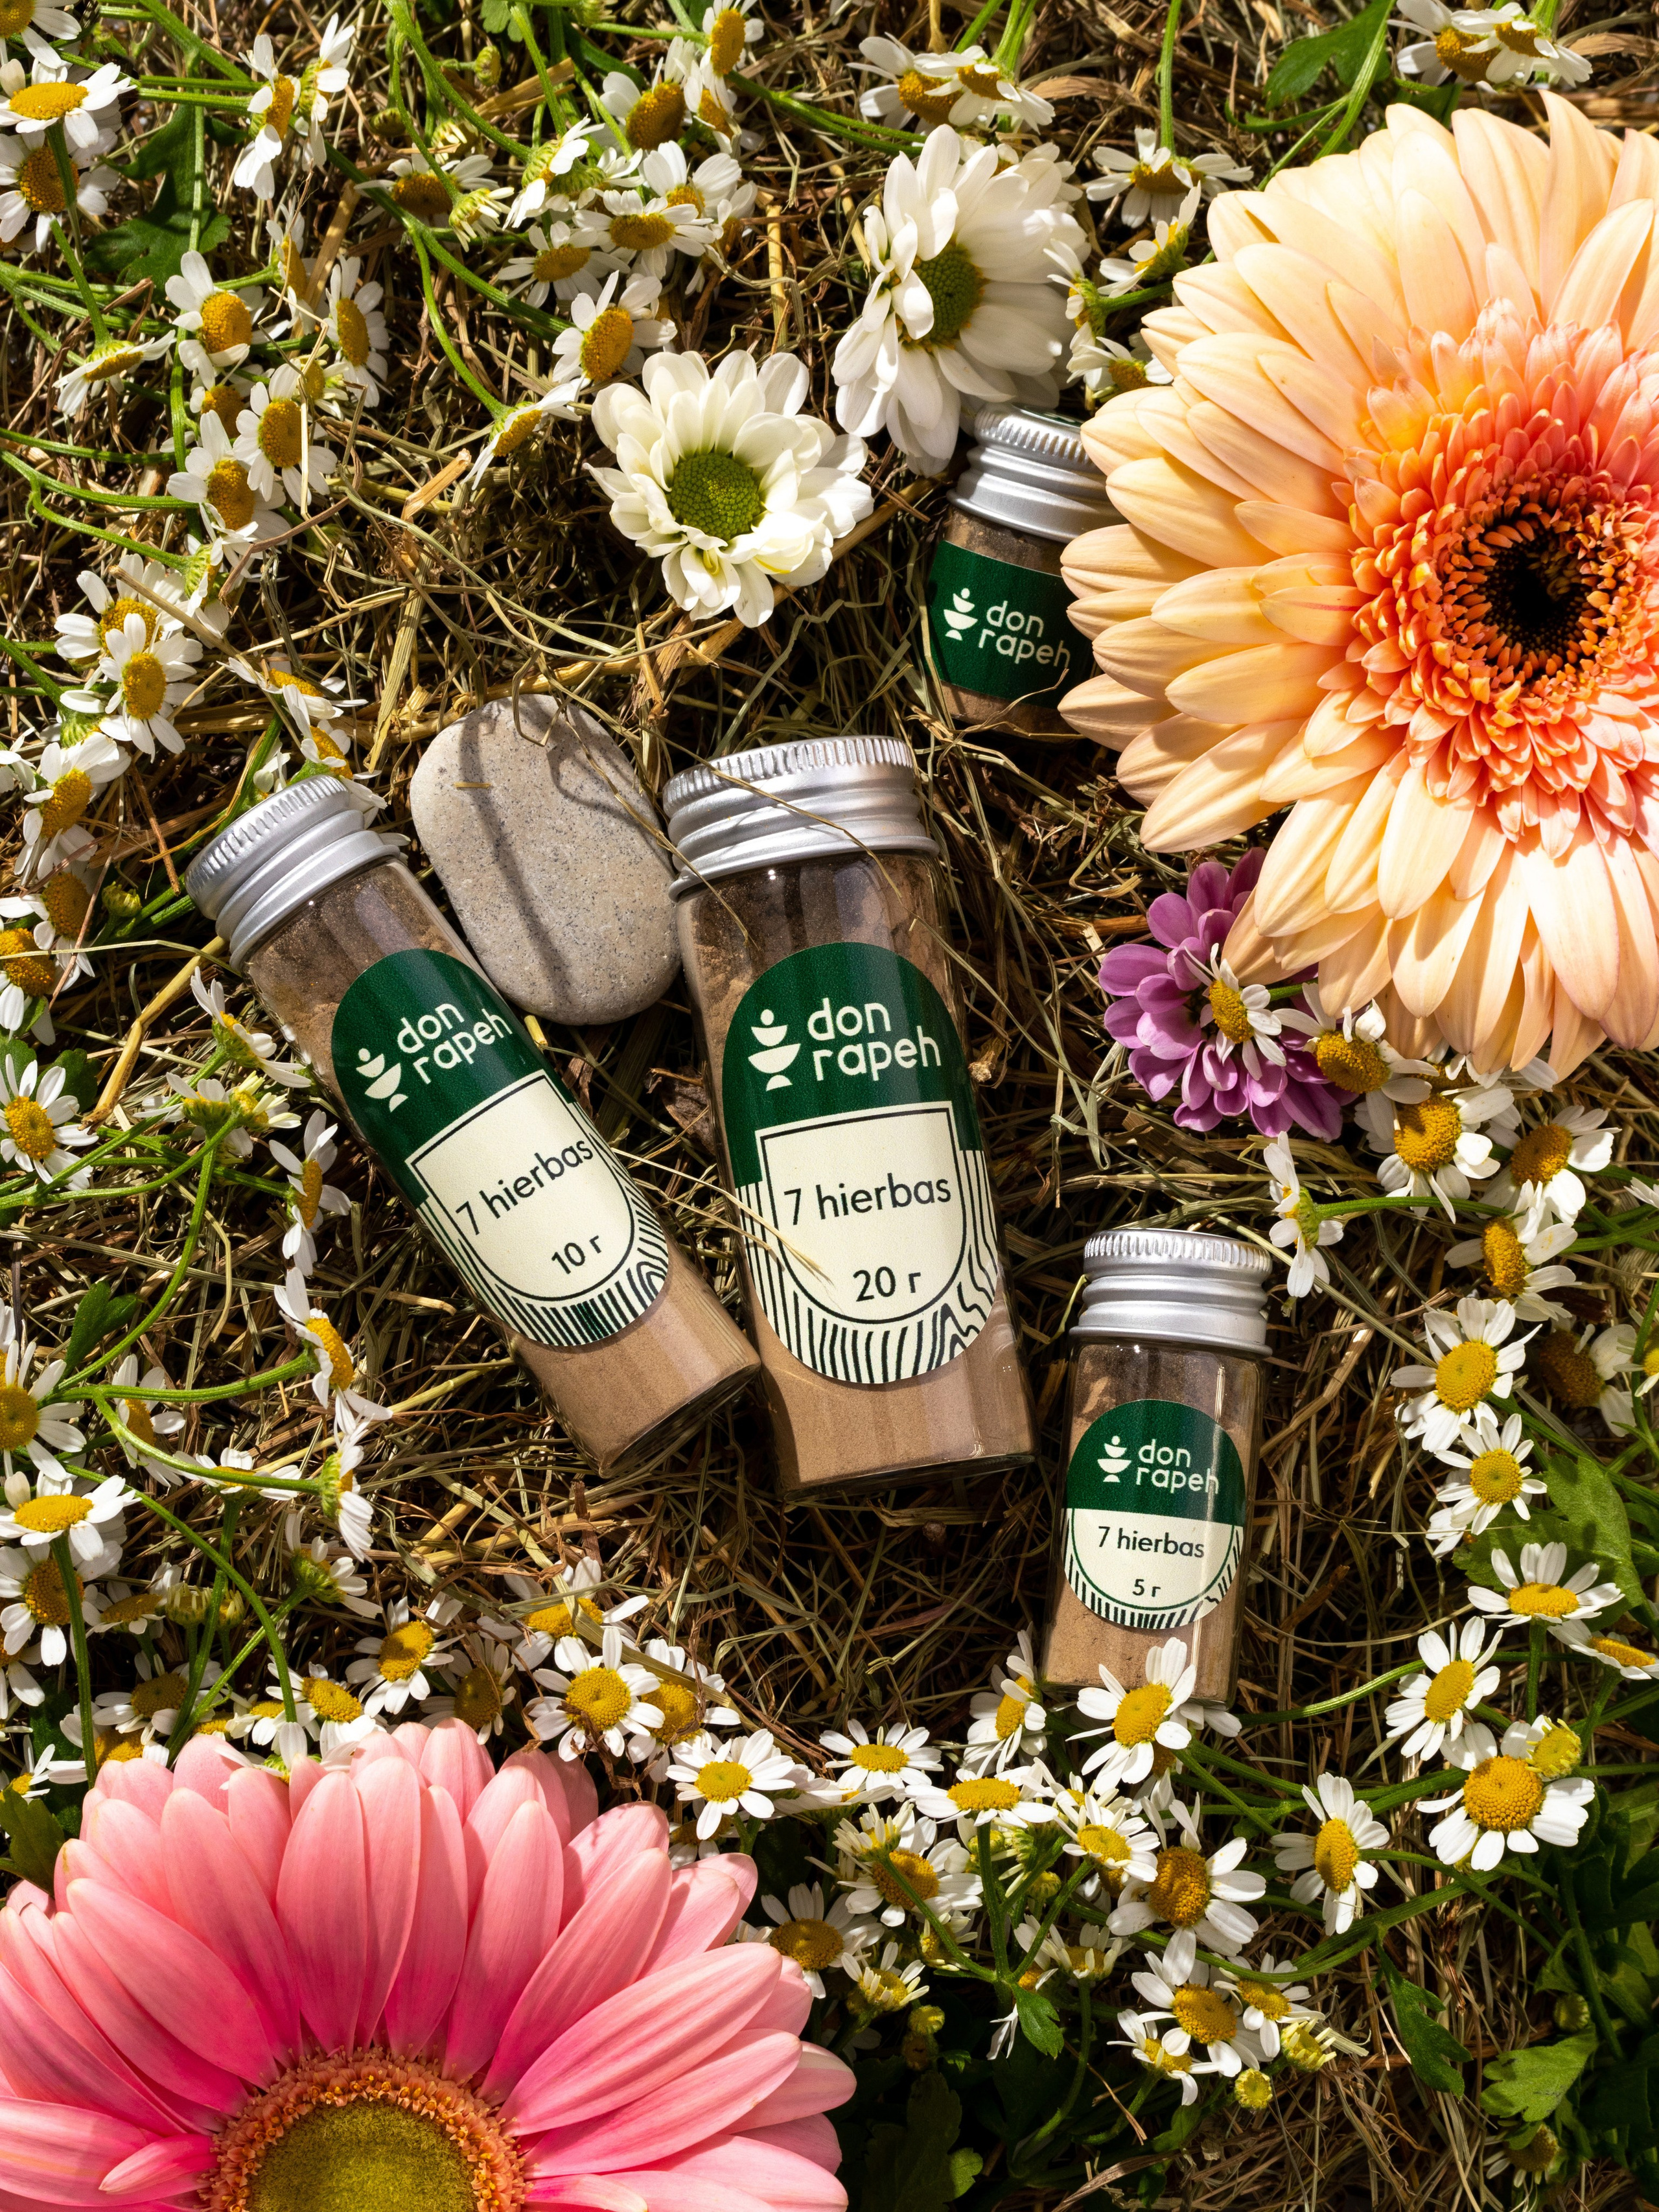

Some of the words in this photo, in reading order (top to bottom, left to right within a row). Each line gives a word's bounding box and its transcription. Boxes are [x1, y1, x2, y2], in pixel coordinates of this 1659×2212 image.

[986, 600, 1044, 637] don
[978, 628, 1071, 668] rapeh
[397, 1003, 465, 1054] don
[807, 997, 891, 1040] don
[413, 1008, 513, 1085] rapeh
[812, 1025, 942, 1082] rapeh
[455, 1201, 480, 1235] 7
[479, 1140, 594, 1219] hierbas
[784, 1189, 802, 1226] 7
[815, 1172, 951, 1220] hierbas
[551, 1242, 586, 1275] 10
[852, 1266, 896, 1302] 20
[1138, 1439, 1190, 1467] don
[1136, 1467, 1219, 1494] rapeh
[1098, 1526, 1111, 1548] 7
[1117, 1527, 1204, 1558] hierbas
[1132, 1578, 1145, 1596] 5
